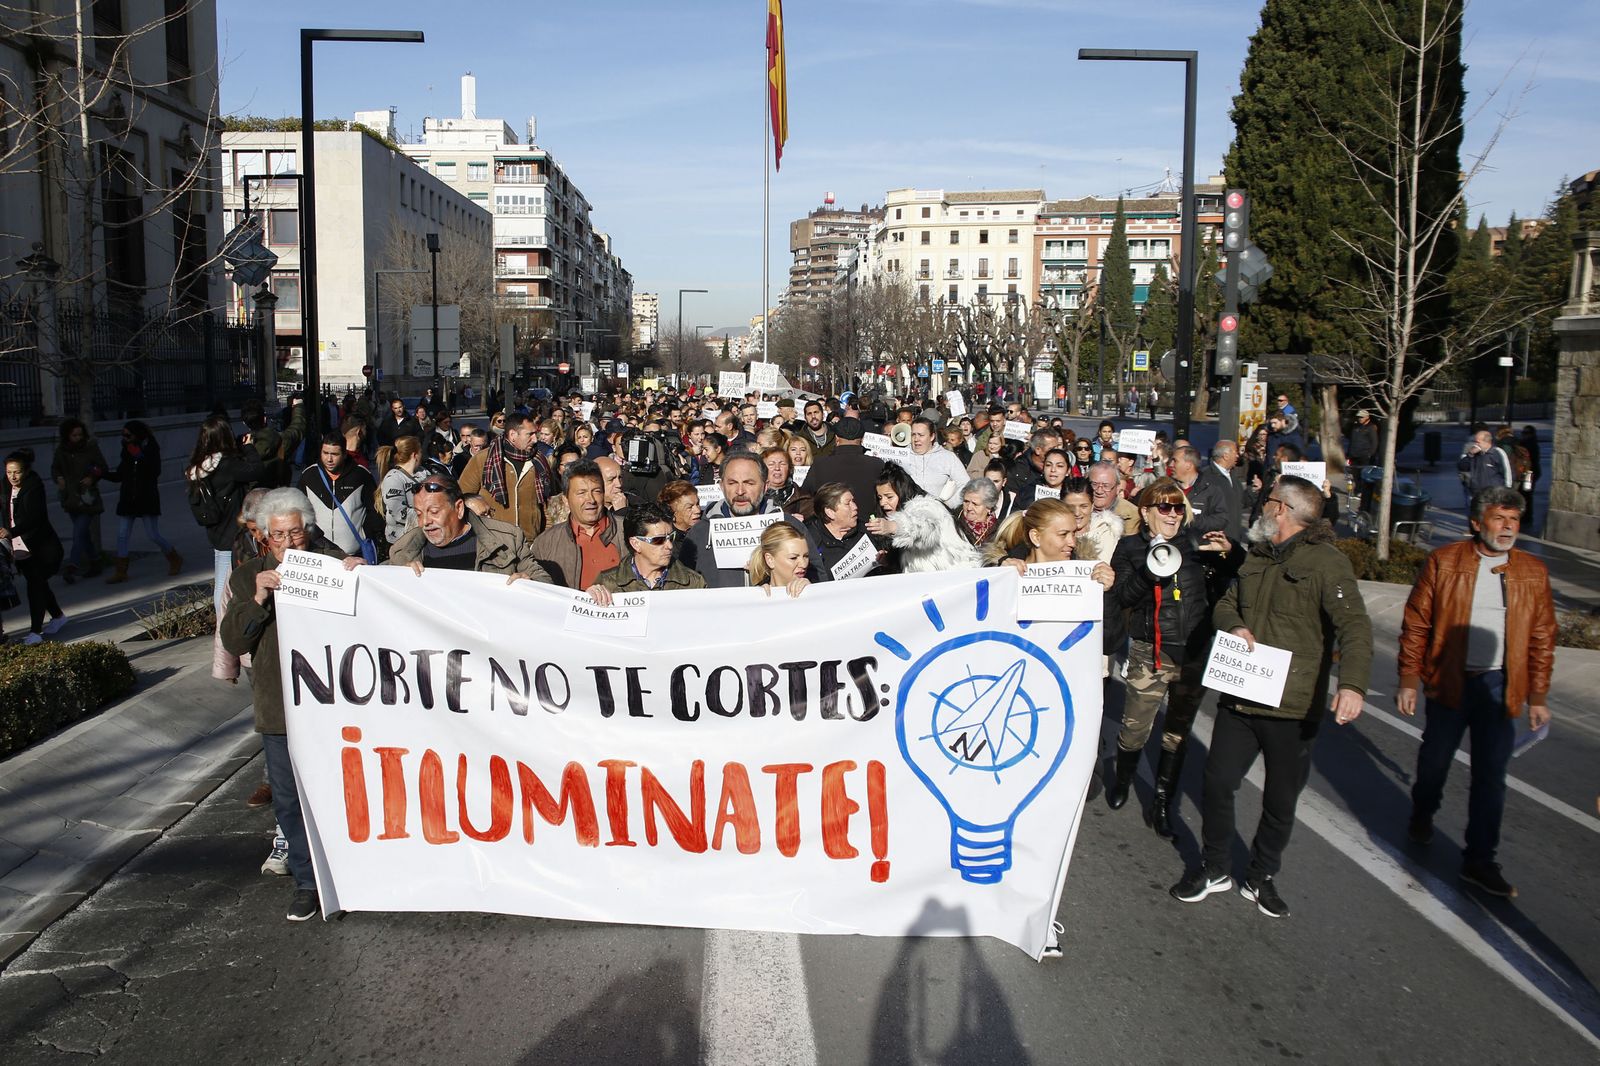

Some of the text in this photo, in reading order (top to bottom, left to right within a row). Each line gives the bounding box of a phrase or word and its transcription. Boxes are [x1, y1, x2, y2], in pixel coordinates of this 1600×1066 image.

[714, 521, 752, 531] ENDESA
[716, 536, 760, 547] MALTRAT
[287, 554, 323, 567] ENDESA
[834, 540, 869, 575] ENDESA NOS
[1075, 566, 1094, 576] NO
[283, 569, 344, 588] ABUSA DE SU
[282, 585, 319, 599] PORDER
[1021, 584, 1082, 594] MALTRATA
[623, 597, 646, 606] NOS
[571, 604, 629, 618] MALTRATA
[1213, 652, 1274, 678] ABUSA DE SU
[291, 643, 891, 722] NORTE NO TE CORTES:
[1208, 667, 1245, 686] PORDER
